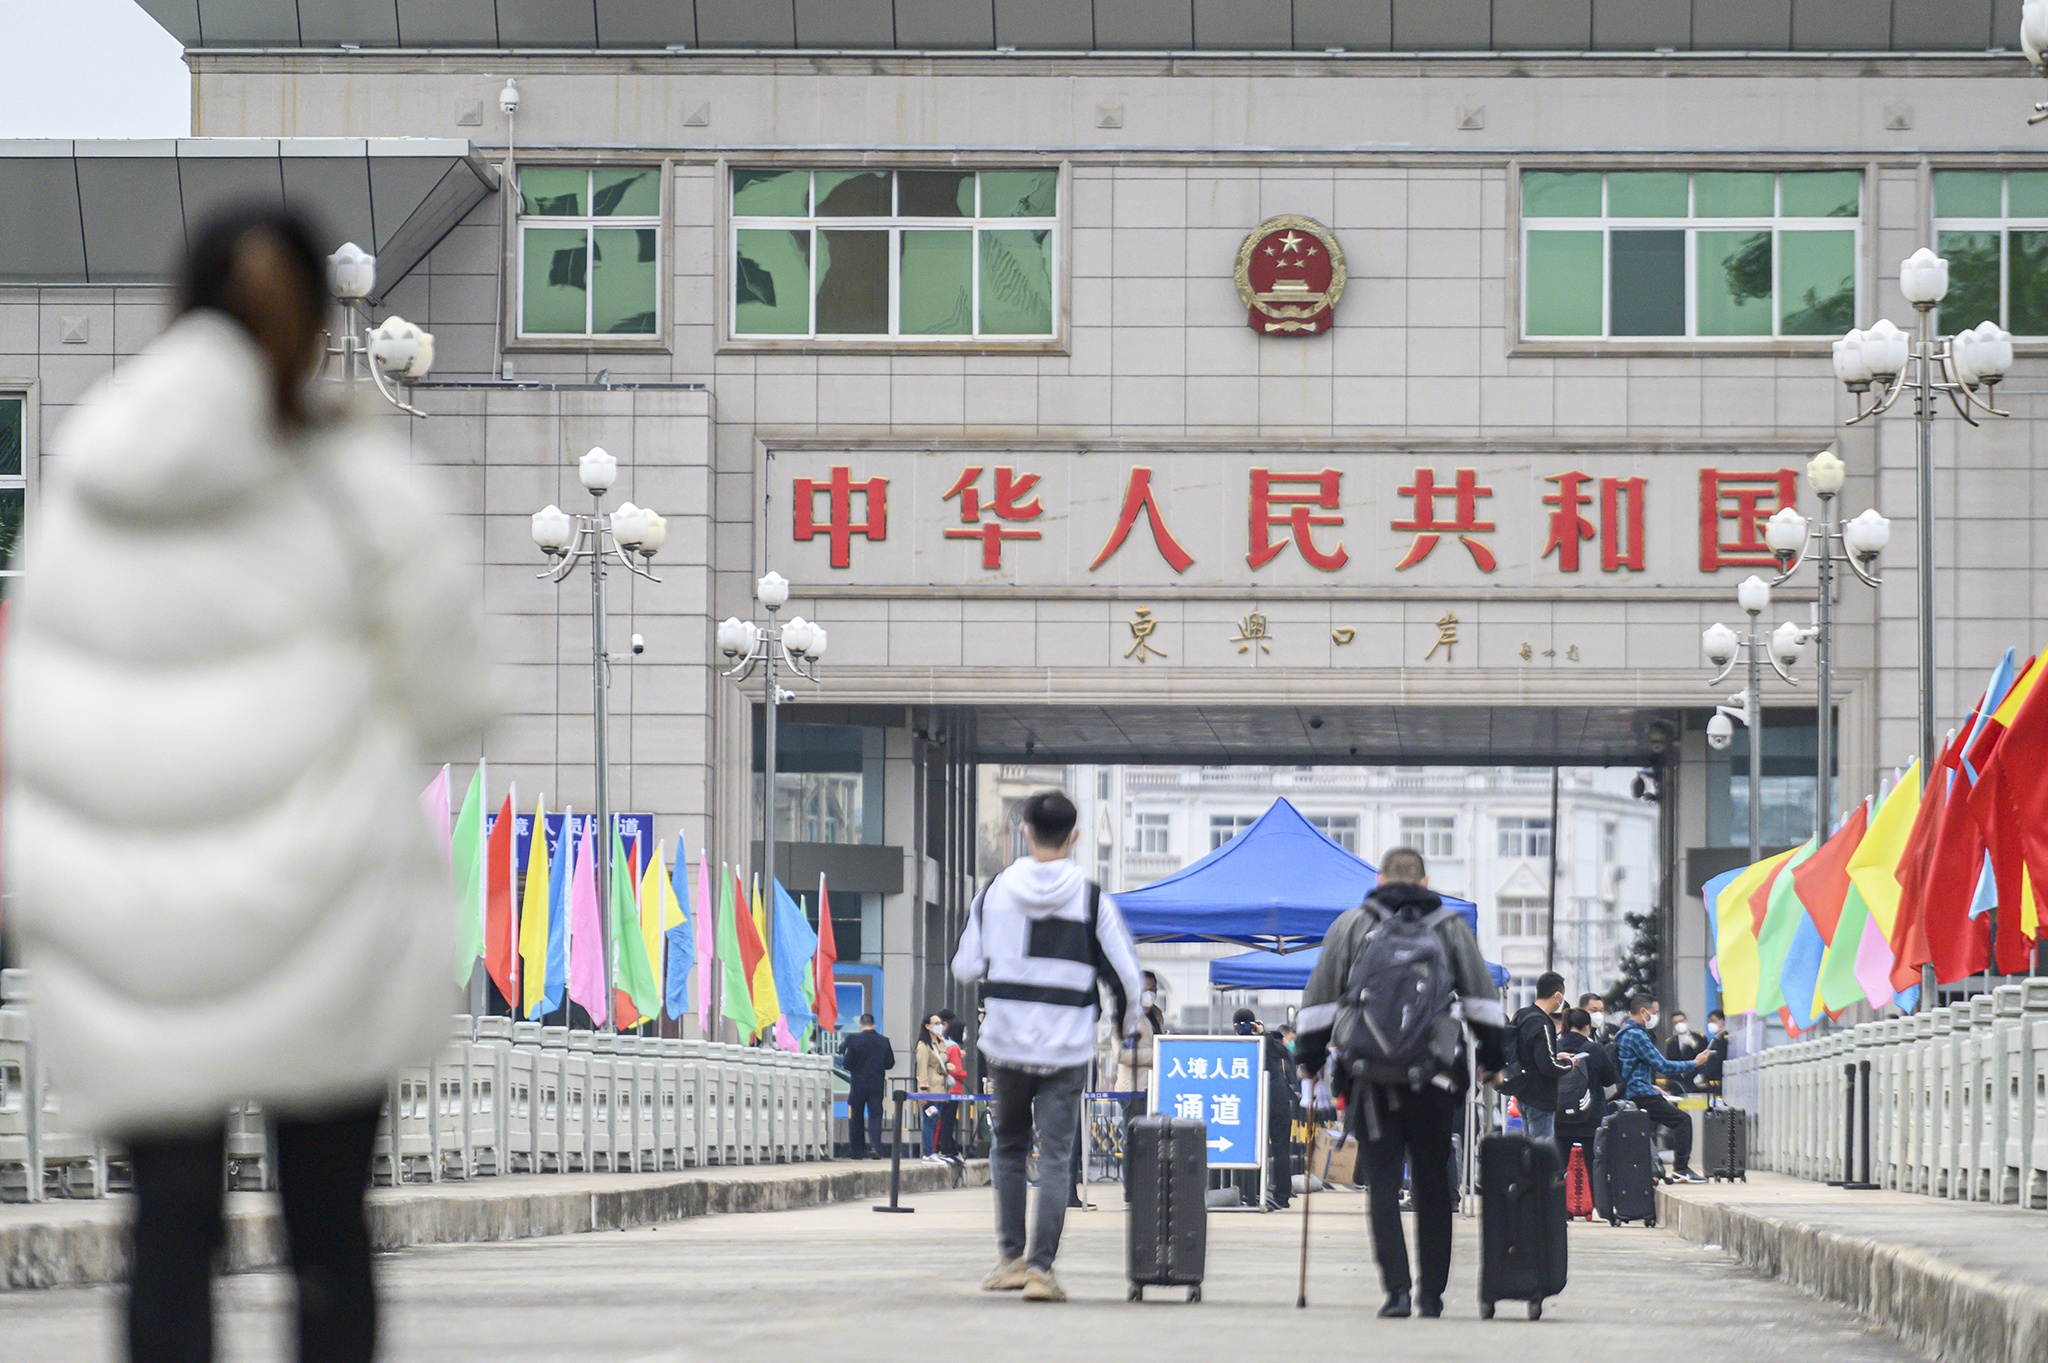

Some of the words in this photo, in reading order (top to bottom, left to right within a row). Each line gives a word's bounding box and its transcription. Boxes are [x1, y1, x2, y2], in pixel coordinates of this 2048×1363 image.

[793, 464, 1799, 574] 中华人民共和国
[1167, 1057, 1250, 1080] 入境人员
[1173, 1093, 1241, 1126] 通道
